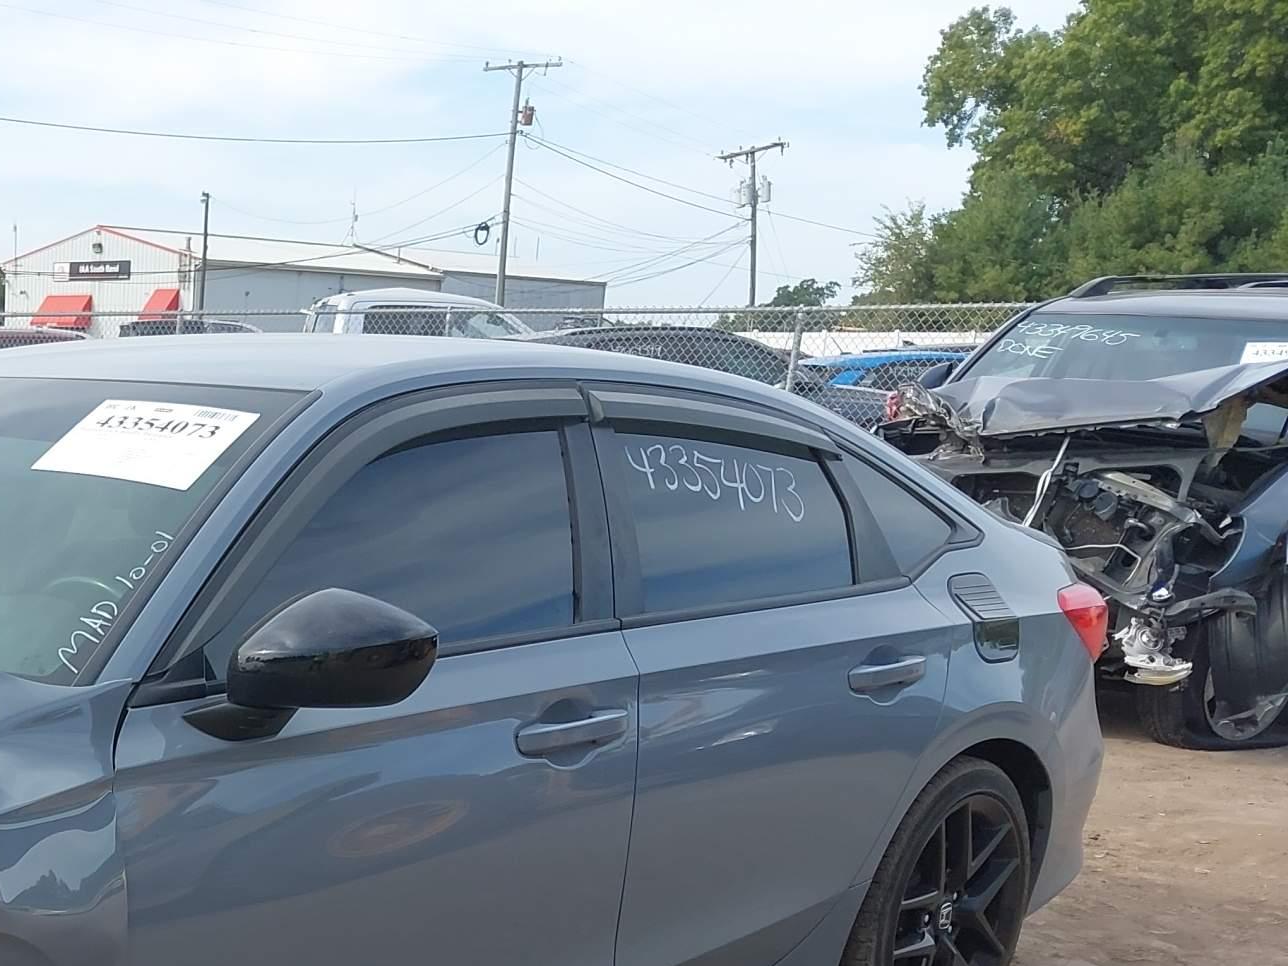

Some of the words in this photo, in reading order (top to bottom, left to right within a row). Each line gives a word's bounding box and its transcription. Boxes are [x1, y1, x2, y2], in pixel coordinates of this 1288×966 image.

[1017, 321, 1141, 346] 43349645
[996, 338, 1064, 359] DONE
[96, 414, 221, 439] 43354073
[624, 444, 804, 521] 43354073
[58, 600, 118, 674] MAD
[115, 530, 174, 590] 10-01
